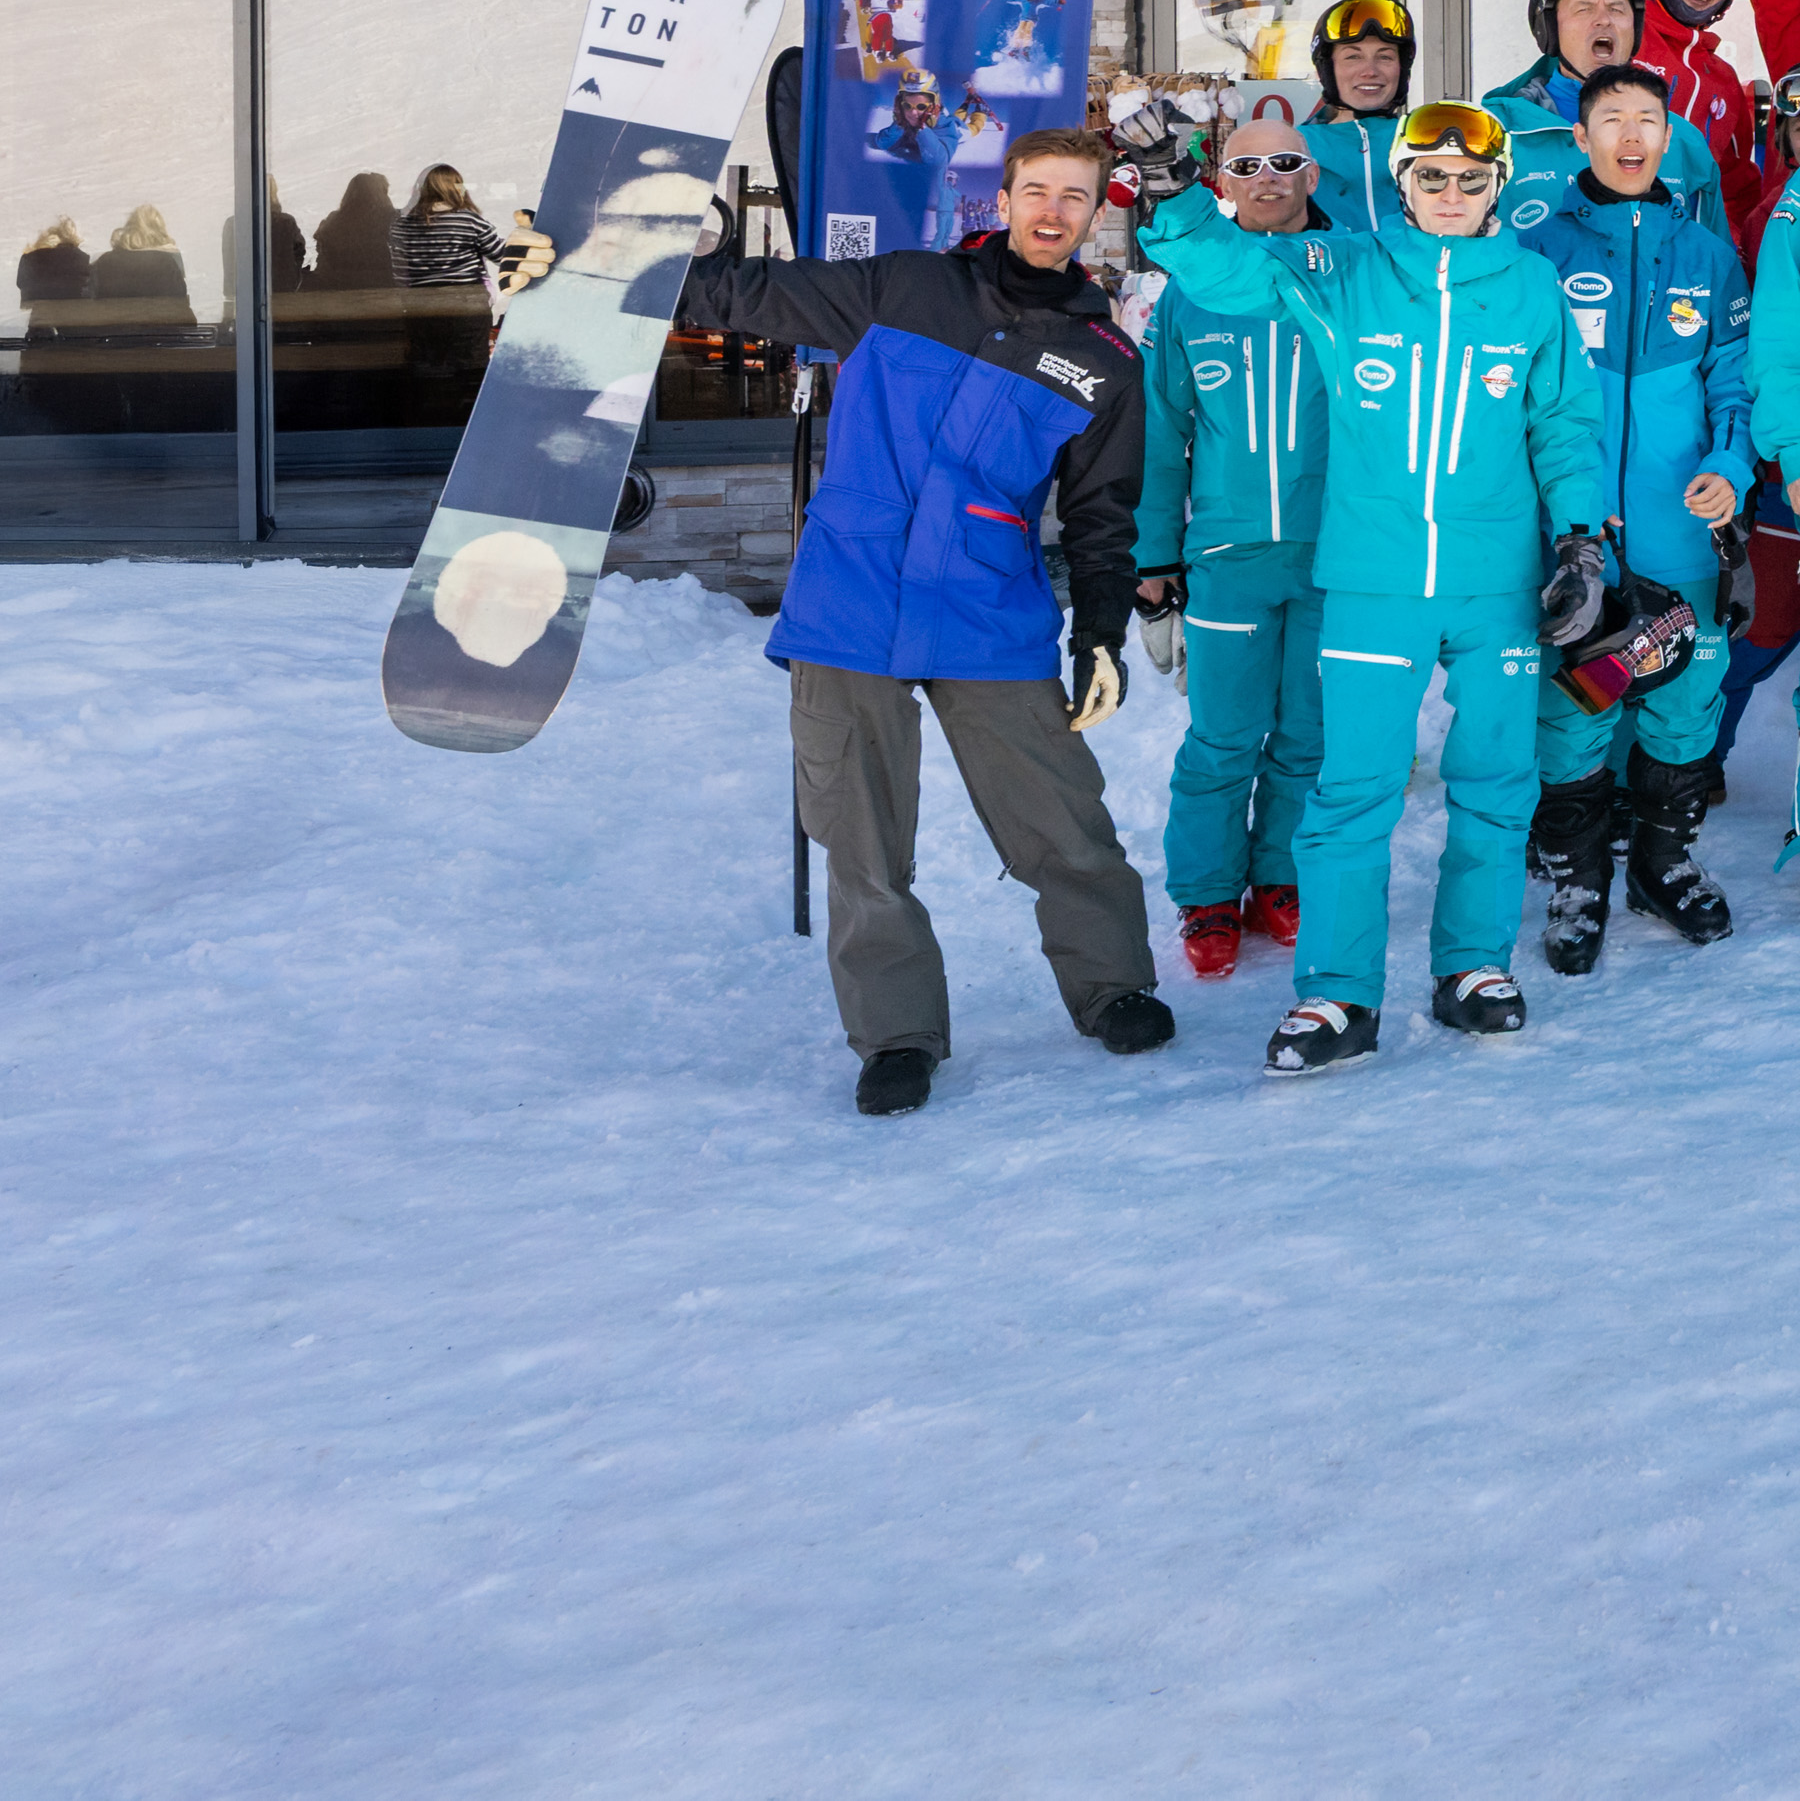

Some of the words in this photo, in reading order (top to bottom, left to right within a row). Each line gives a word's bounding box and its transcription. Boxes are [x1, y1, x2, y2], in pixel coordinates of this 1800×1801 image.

[600, 6, 678, 42] TON
[1572, 281, 1604, 291] Thoma
[1667, 287, 1690, 296] EUROPA
[1692, 289, 1710, 297] PARK
[1036, 363, 1070, 385] feldberg
[1039, 357, 1081, 380] fahrschule
[1042, 352, 1089, 376] snowboard
[1196, 370, 1223, 381] Thoma
